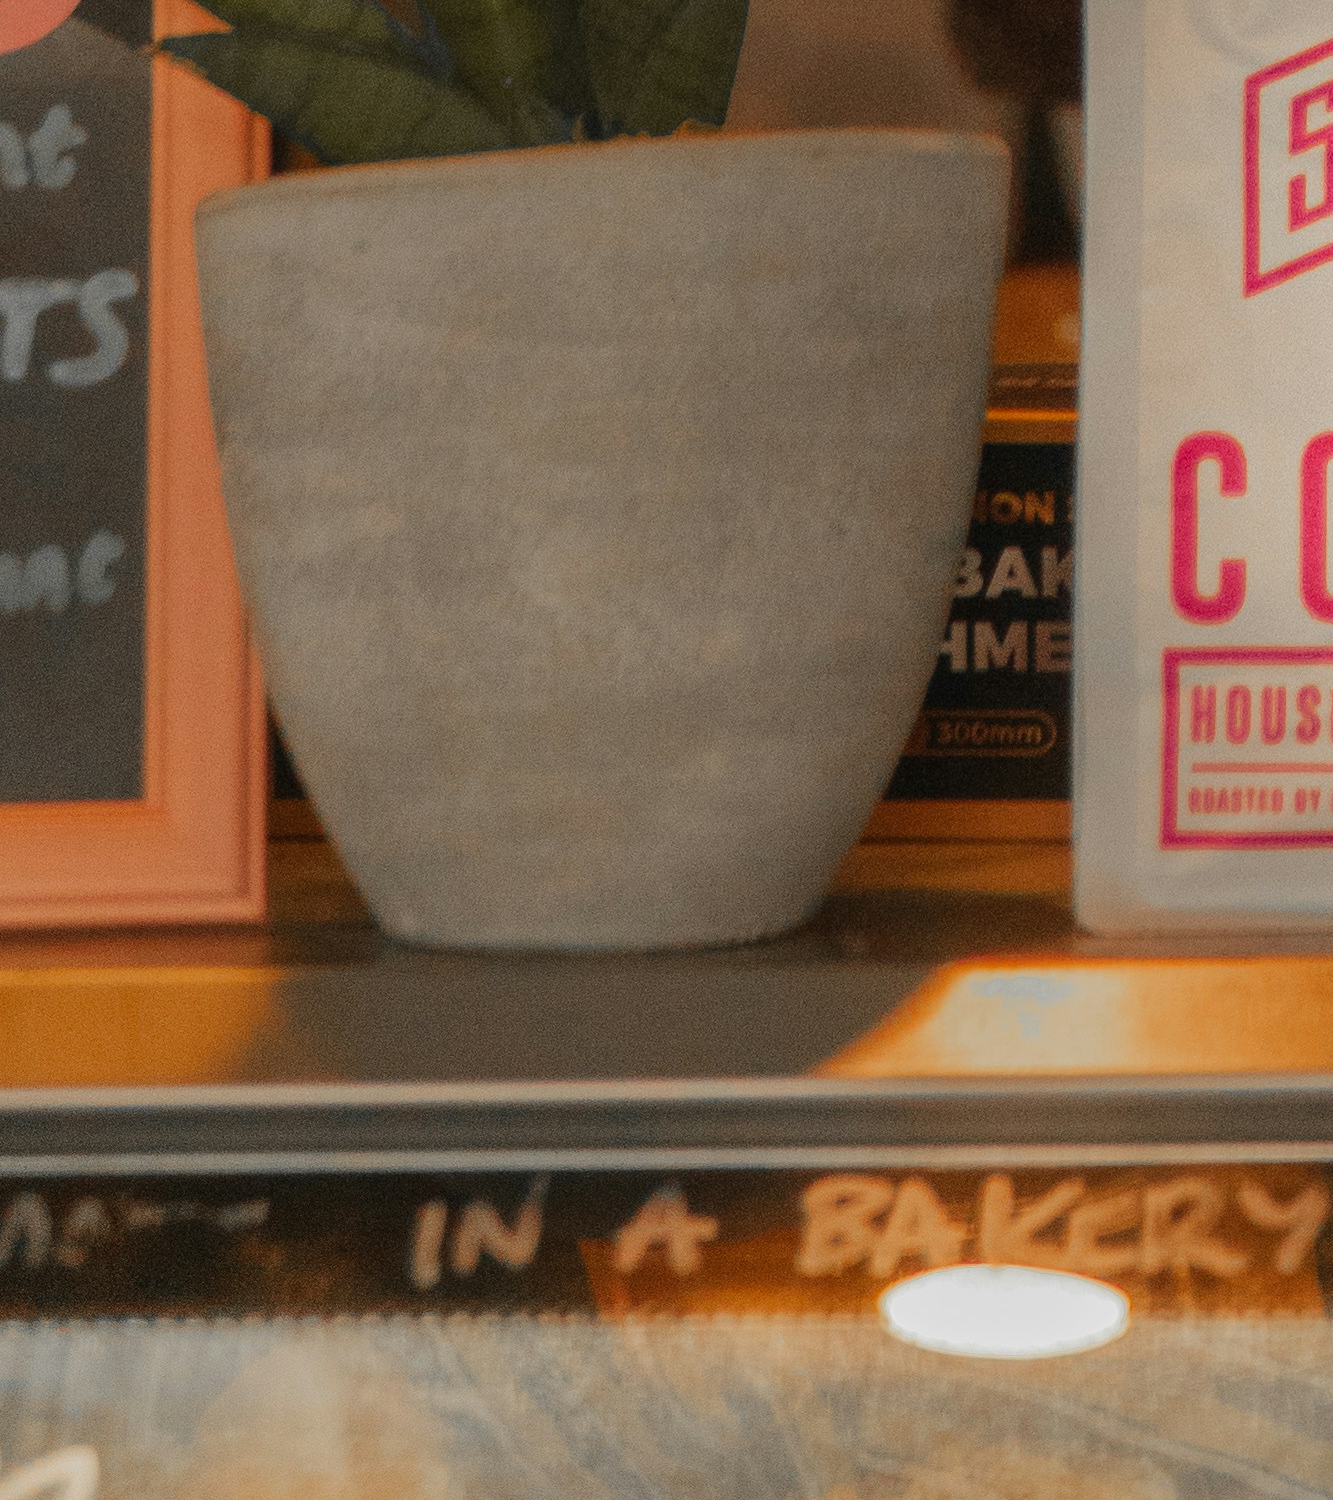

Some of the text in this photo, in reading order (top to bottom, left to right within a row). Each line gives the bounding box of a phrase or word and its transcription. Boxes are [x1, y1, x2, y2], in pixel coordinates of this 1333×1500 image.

[1187, 785, 1285, 815] ROASTED
[1292, 786, 1322, 815] BY
[408, 1172, 552, 1292] IN
[613, 1184, 720, 1276] A
[800, 1172, 1330, 1278] BAKERY
